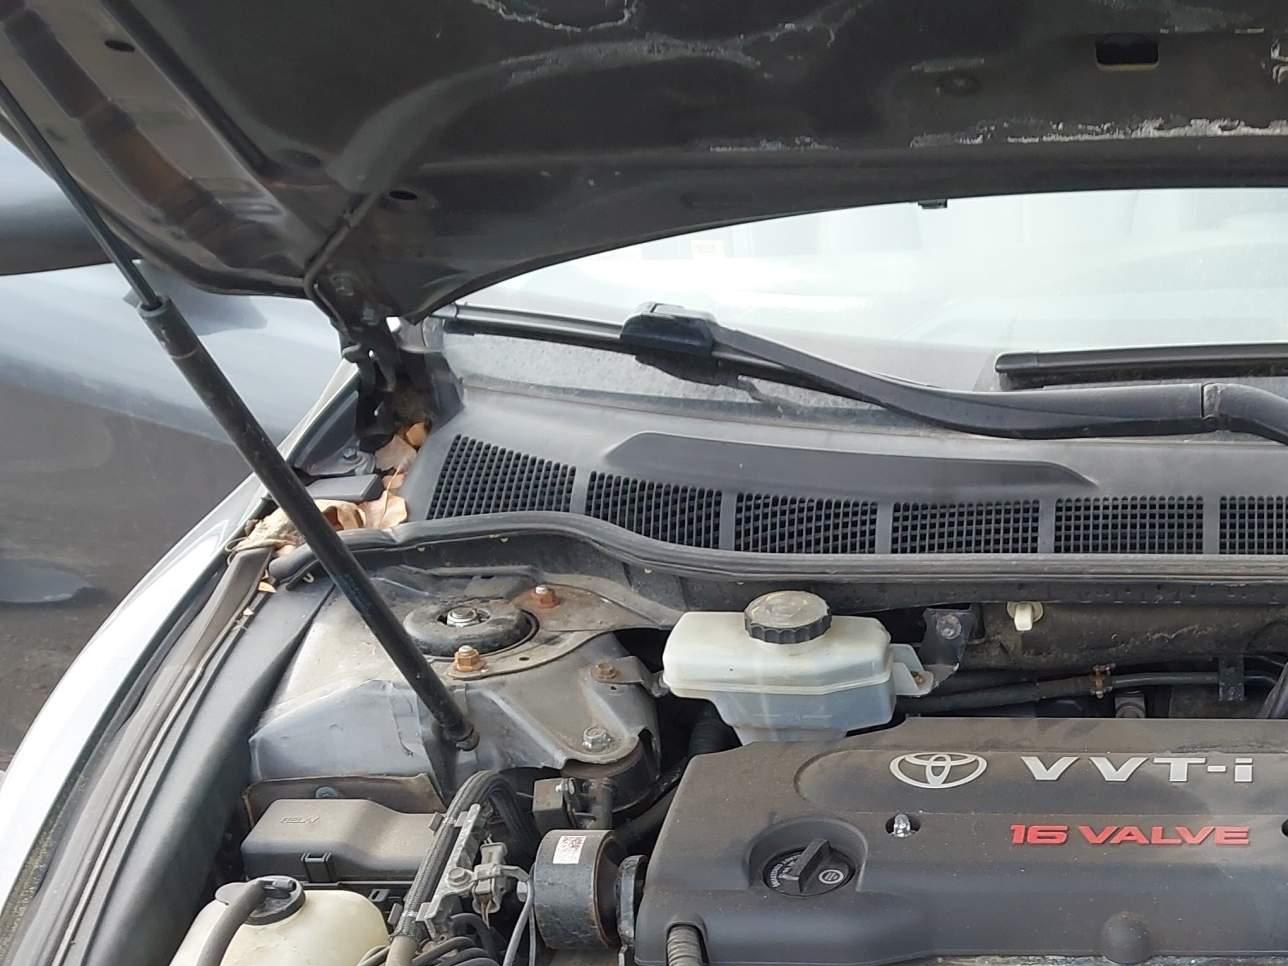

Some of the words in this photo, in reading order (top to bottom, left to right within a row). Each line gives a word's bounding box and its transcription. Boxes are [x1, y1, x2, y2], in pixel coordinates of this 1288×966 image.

[1020, 755, 1254, 783] VVT-i
[1010, 824, 1069, 844] 16
[1079, 825, 1250, 845] VALVE
